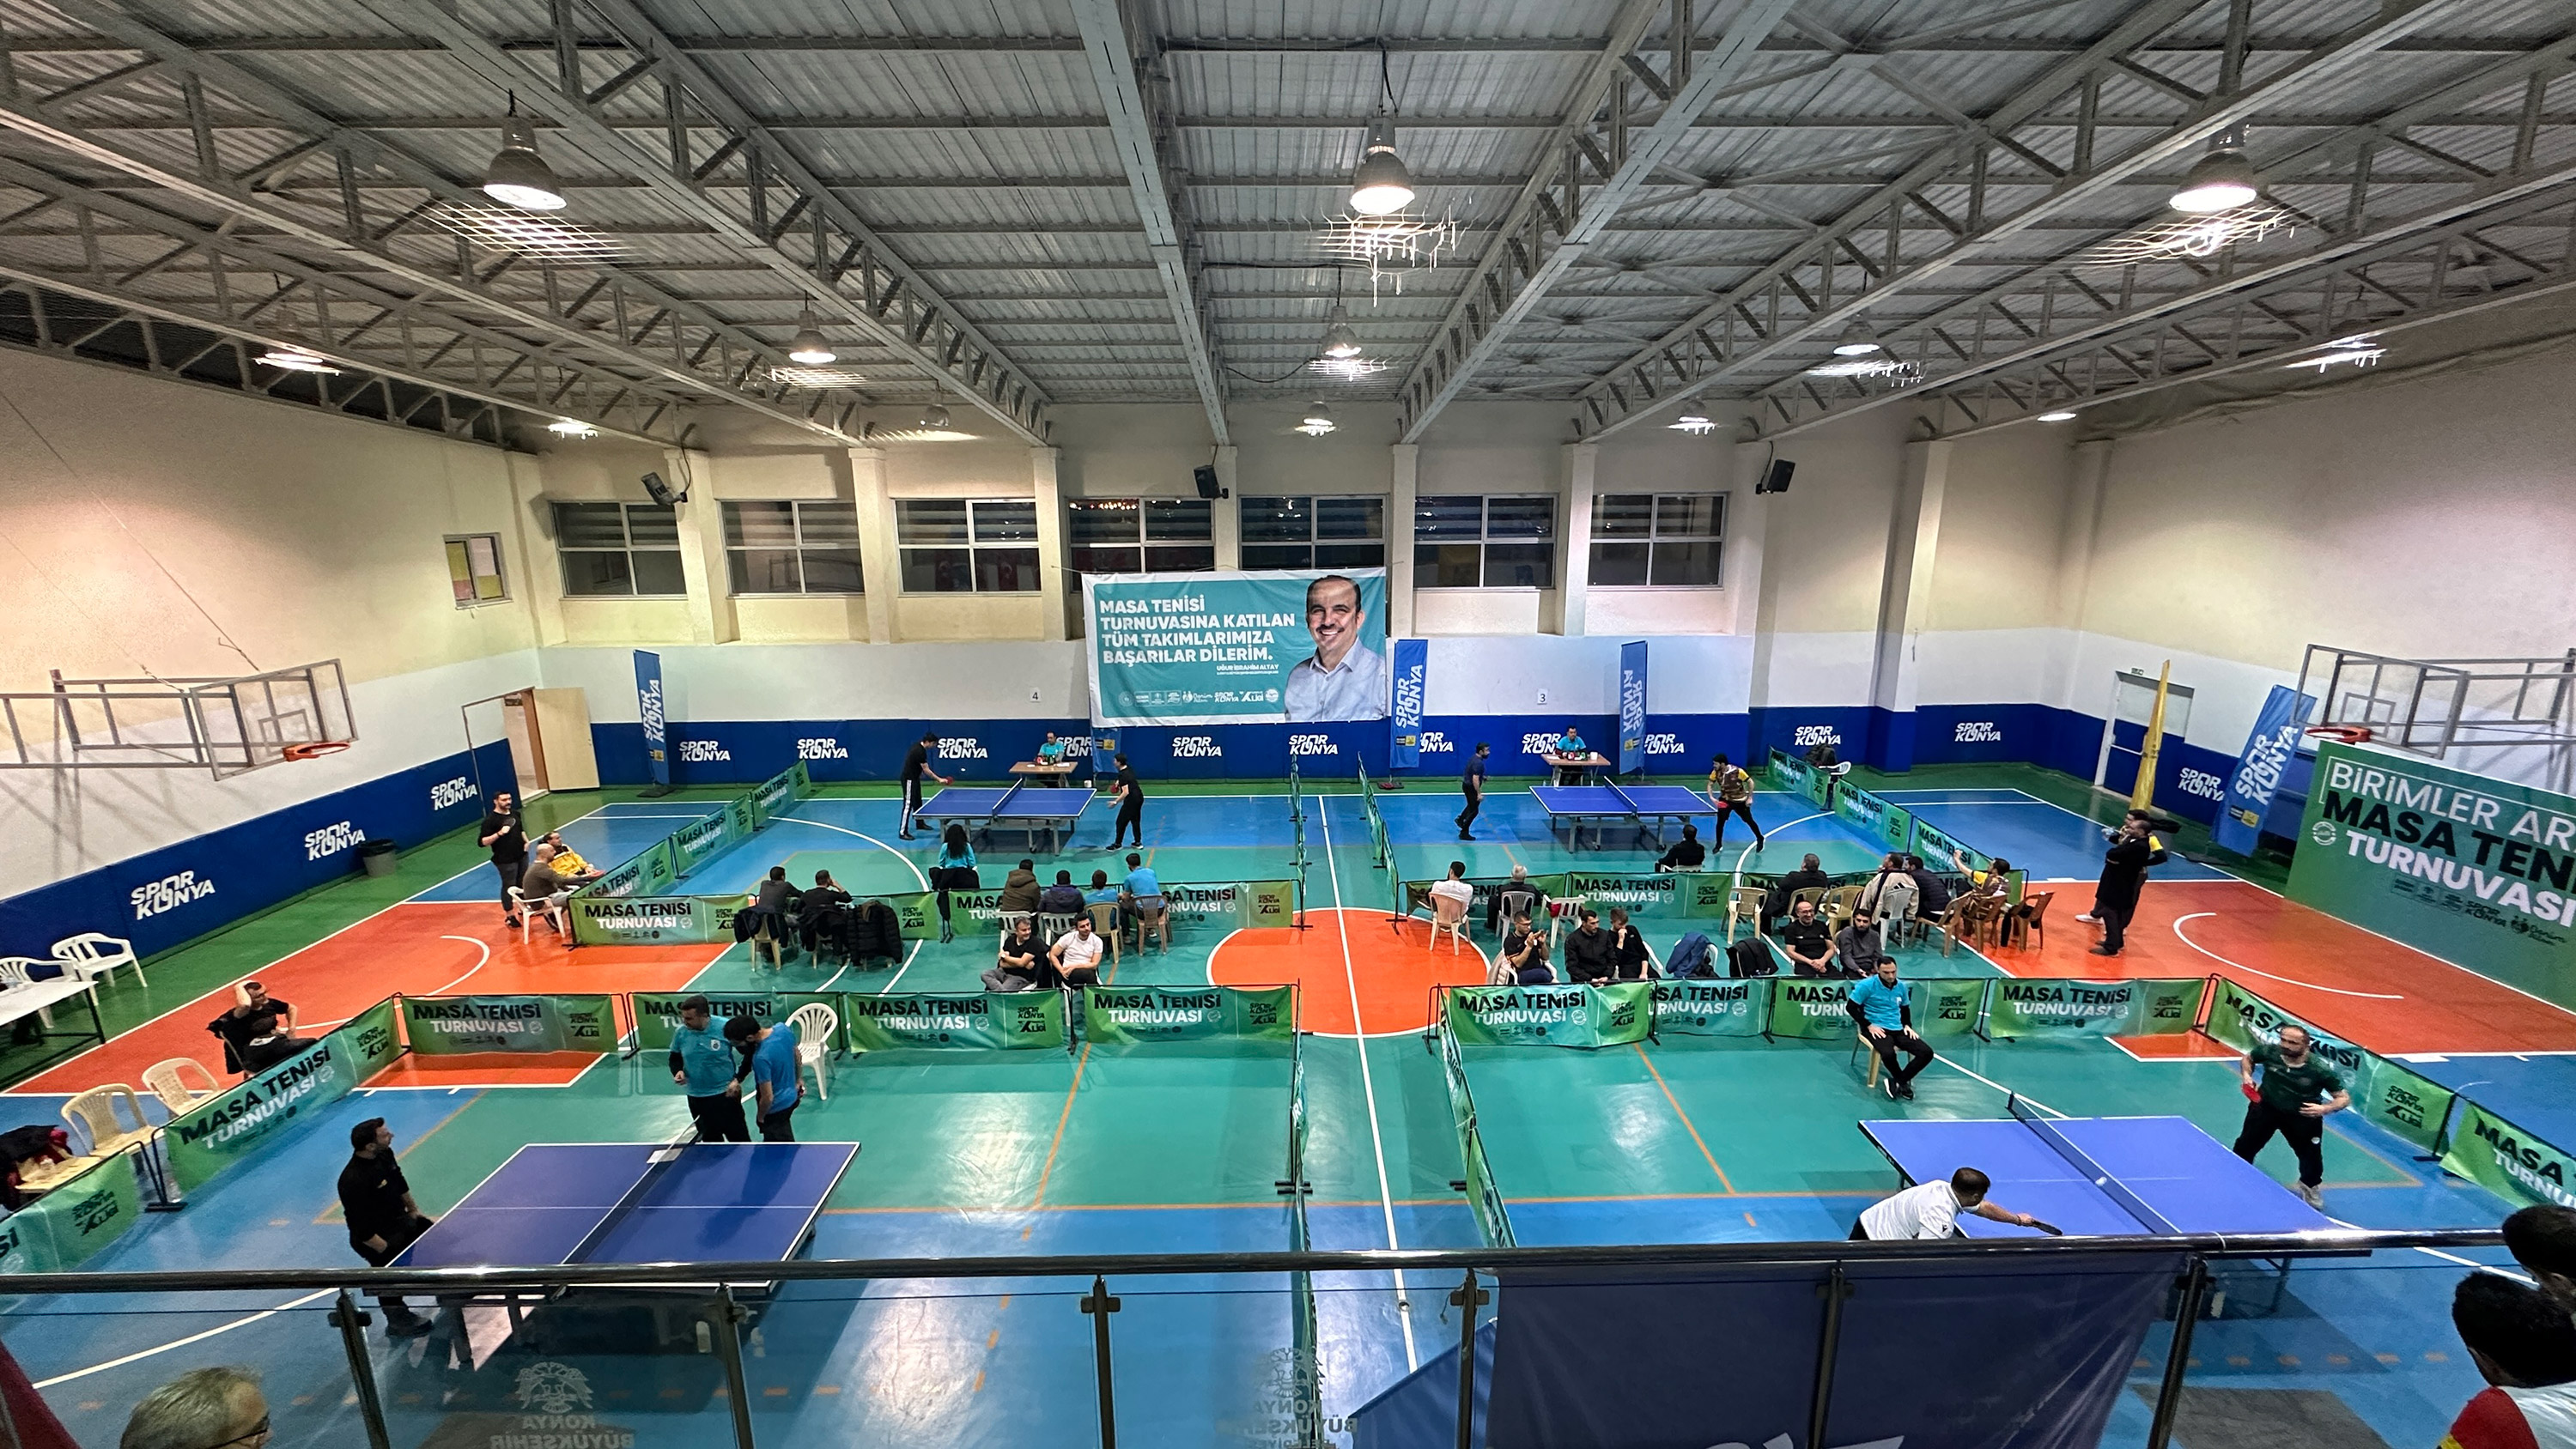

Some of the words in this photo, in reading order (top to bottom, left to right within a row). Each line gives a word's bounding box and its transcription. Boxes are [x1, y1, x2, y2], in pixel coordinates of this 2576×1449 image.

[1100, 600, 1149, 614] MASA
[1151, 594, 1205, 613] TENİSİ
[1100, 615, 1221, 631] TURNUVASINA
[1224, 613, 1296, 627] KATILAN
[1102, 631, 1142, 648] TÜM
[1143, 630, 1275, 646] TAKIMLARIMIZA
[1103, 649, 1197, 667] BAŞARILAR
[1200, 645, 1273, 663] DİLERİM.
[1405, 664, 1423, 727] KONYA
[1540, 694, 1546, 702] 3
[1795, 725, 1833, 737] SPOR
[1955, 722, 1993, 733] SPOR
[1172, 737, 1212, 748] SPOR
[1289, 734, 1328, 746] SPOR
[1645, 734, 1676, 744] POR
[1795, 732, 1841, 745] KONYA
[1954, 729, 2001, 742] KONYA
[679, 741, 719, 752] SPOR
[797, 738, 836, 749] SPOR
[938, 738, 976, 749] SPOR
[1174, 743, 1222, 757] KONYA
[1289, 741, 1338, 755] KONYA
[681, 748, 731, 761] KONYA
[799, 745, 848, 759] KONYA
[939, 745, 987, 759] KONYA
[2235, 734, 2274, 799] SPOR
[2252, 725, 2300, 805] KONYA
[2179, 767, 2221, 789] SPOR
[431, 776, 466, 799] SPOR
[434, 783, 477, 810] KONYA
[2322, 791, 2457, 857] MASA
[2509, 810, 2576, 852] AR
[304, 821, 351, 847] SPOR
[307, 828, 366, 861] KONYA
[1576, 879, 1625, 891] MASA
[2346, 830, 2576, 928] TURNUVASI
[131, 870, 194, 906] SPOR
[137, 879, 216, 920] KONYA
[1586, 891, 1659, 903] TURNUVASI
[585, 905, 638, 918] MASA
[1166, 901, 1221, 913] RNUVASI
[596, 917, 677, 929] TURNUVASI
[1786, 986, 1847, 1002] MASA
[2003, 986, 2063, 1001] MASA
[859, 1000, 921, 1016] MASA
[1094, 994, 1156, 1009] MASA
[1460, 993, 1519, 1012] MASA
[2014, 1002, 2111, 1016] TURNUVASI
[413, 1004, 476, 1020] MASA
[1109, 1009, 1201, 1023] TURNUVASI
[1473, 1009, 1566, 1026] TURNUVASI
[429, 1020, 525, 1034] TURNUVASI
[874, 1016, 969, 1029] TURNUVASI
[179, 1091, 263, 1145] MASA
[202, 1076, 315, 1149] TURNUVASI
[2474, 1118, 2563, 1186] MASA
